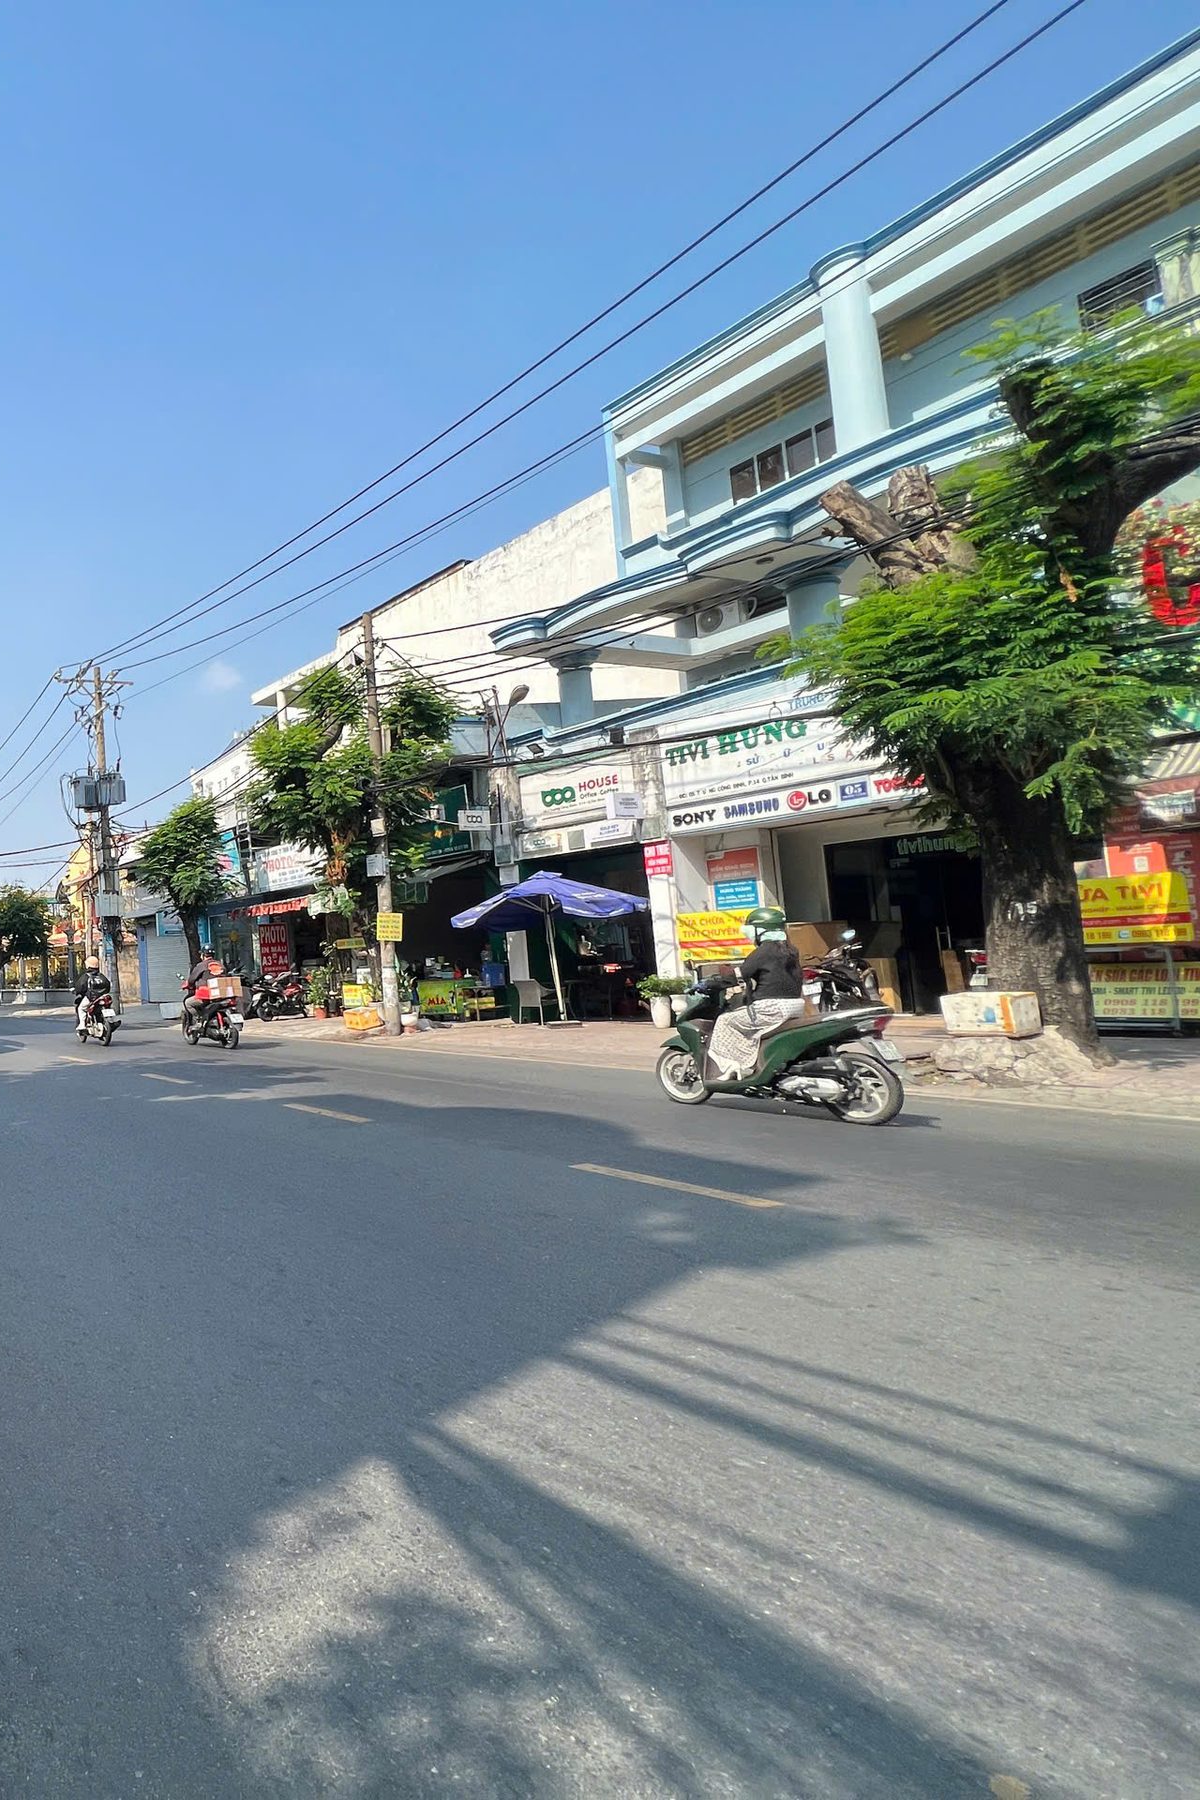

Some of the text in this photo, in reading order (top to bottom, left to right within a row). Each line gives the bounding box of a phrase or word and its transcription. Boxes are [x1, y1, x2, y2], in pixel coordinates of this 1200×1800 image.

[664, 739, 710, 767] TIVI
[578, 774, 619, 792] HOUSE
[844, 783, 863, 795] 05
[672, 809, 717, 827] SONY
[1116, 882, 1163, 901] TIVI
[259, 925, 286, 944] PHOTO
